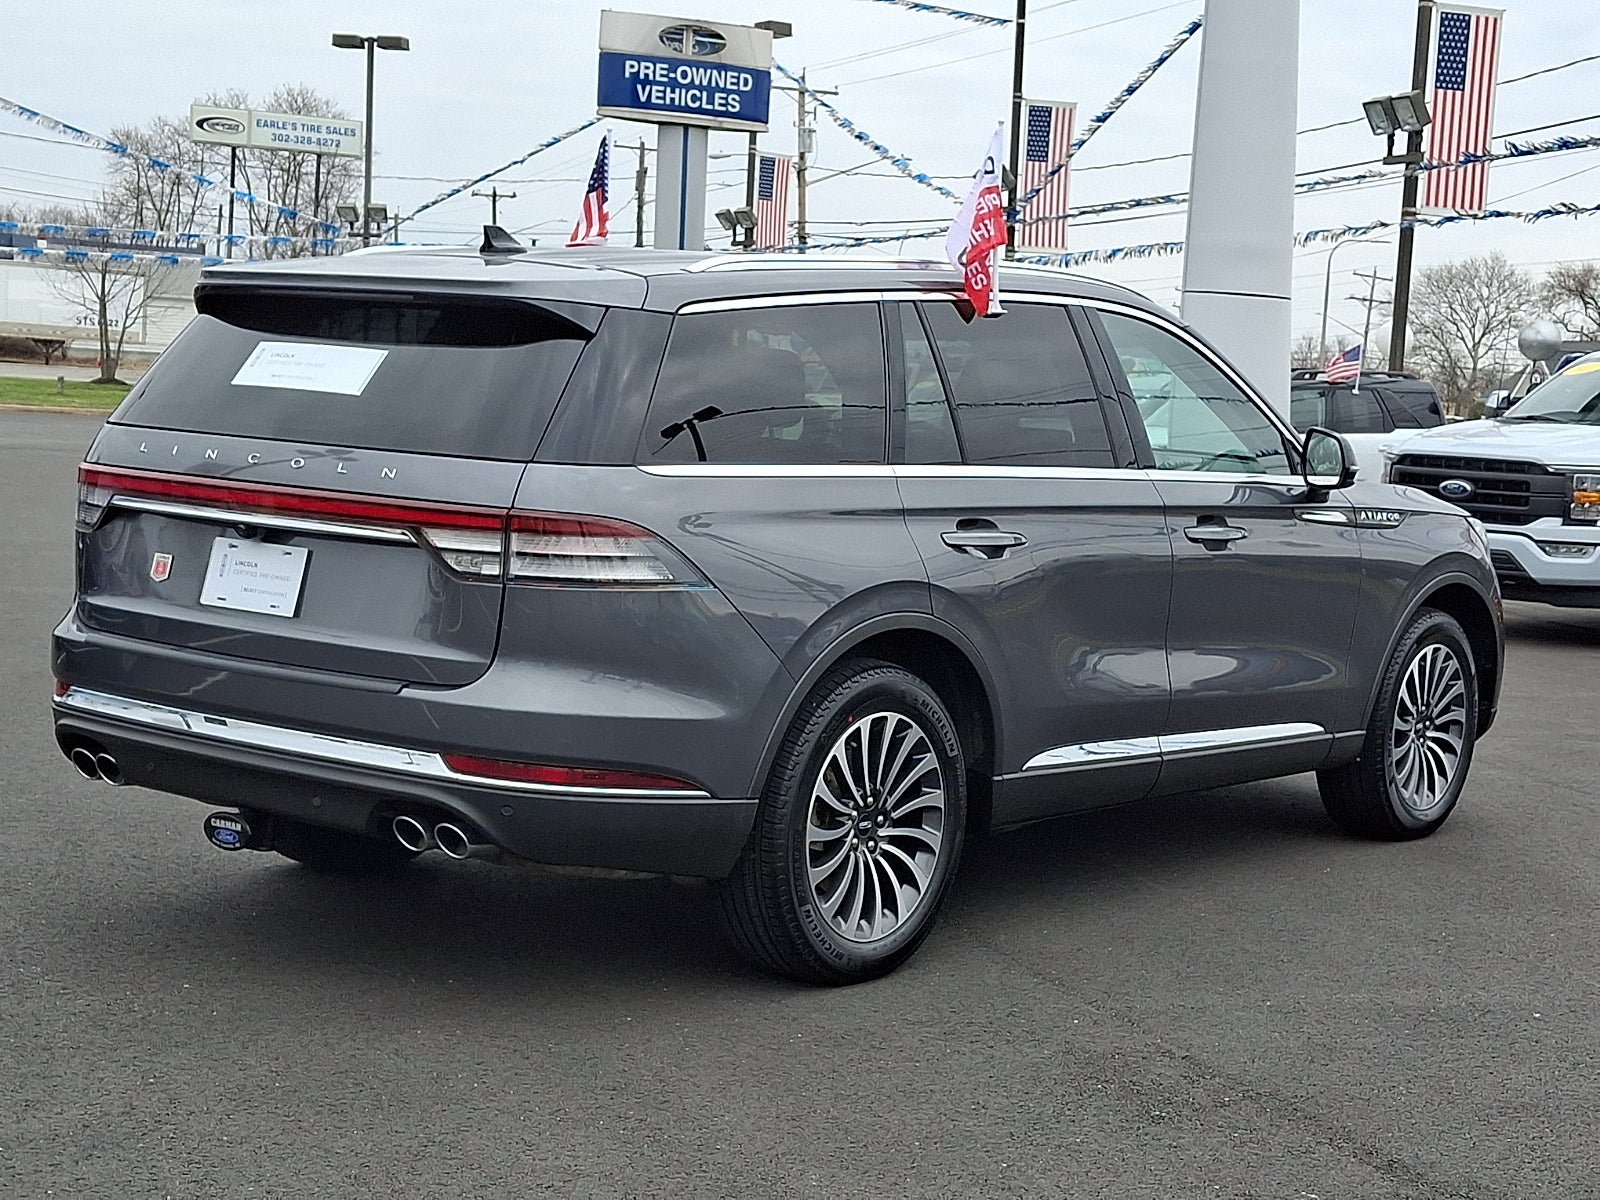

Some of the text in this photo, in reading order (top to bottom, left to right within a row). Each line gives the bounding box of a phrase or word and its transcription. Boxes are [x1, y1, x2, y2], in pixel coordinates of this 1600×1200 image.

[624, 60, 753, 92] PRE-OWNED
[636, 84, 741, 113] VEHICLES
[256, 119, 357, 137] EARLE'S TIRE SALES
[270, 132, 341, 148] 302-328-8272
[138, 442, 398, 479] LINCOLN
[234, 559, 258, 568] LINCOLN
[919, 698, 956, 754] MICHELIN
[210, 817, 242, 831] CARMAN
[803, 908, 846, 961] MICHELIN
